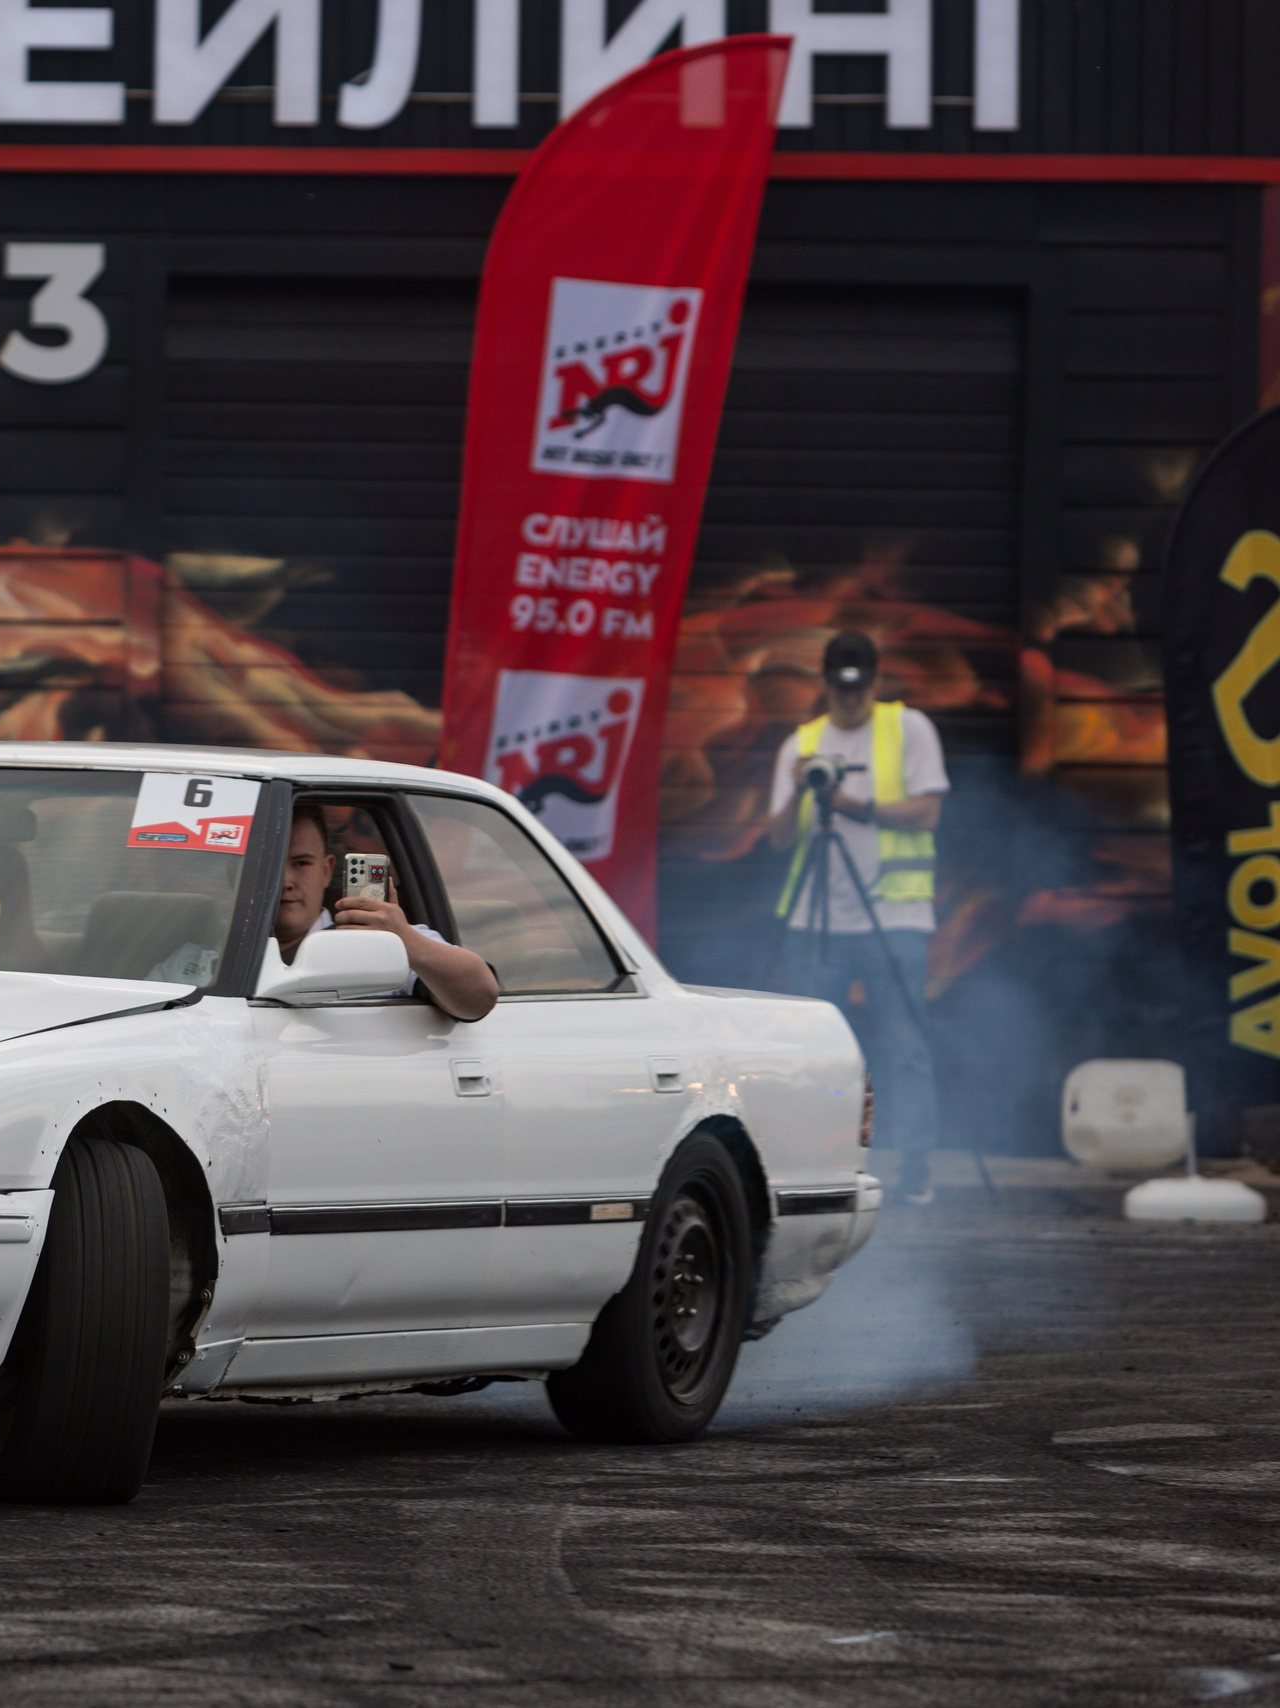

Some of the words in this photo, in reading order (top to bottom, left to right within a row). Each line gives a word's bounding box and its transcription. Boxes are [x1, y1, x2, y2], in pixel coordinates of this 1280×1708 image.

[521, 512, 667, 556] СЛУШАЙ
[514, 552, 660, 598] ENERGY
[510, 595, 595, 636] 95.0
[601, 607, 655, 641] FM
[183, 778, 214, 808] 6
